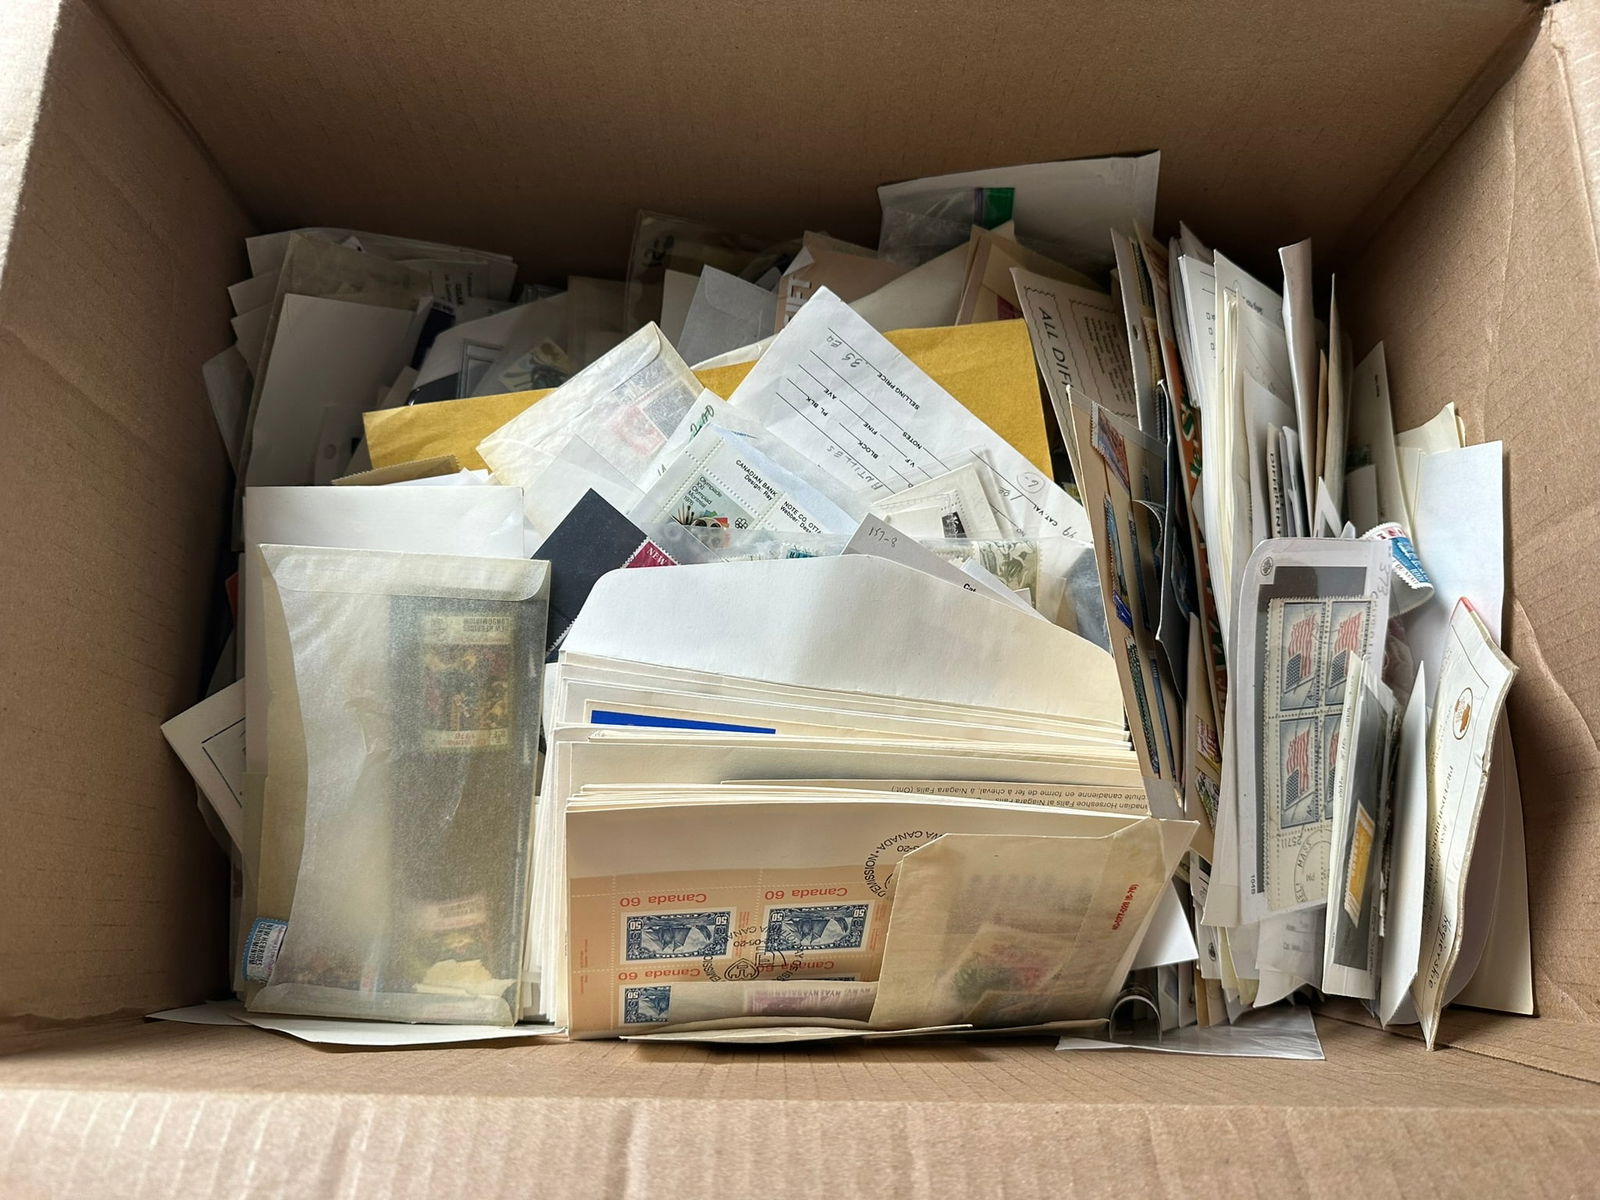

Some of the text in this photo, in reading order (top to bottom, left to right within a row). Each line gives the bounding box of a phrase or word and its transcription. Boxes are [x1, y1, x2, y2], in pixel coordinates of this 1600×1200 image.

[1039, 307, 1058, 339] ALL
[823, 388, 837, 400] AVE
[877, 372, 920, 410] SELLING PRICE
[805, 396, 820, 409] BLK
[862, 422, 878, 436] FINE
[902, 431, 923, 449] NOTES
[857, 440, 879, 460] BLOCK
[699, 476, 723, 498] Olympiade
[735, 459, 762, 485] CANADIAN
[760, 480, 778, 498] BANK
[784, 501, 799, 517] NOTE
[1270, 452, 1281, 535] DIFFERENT
[684, 495, 694, 506] 1976
[691, 485, 712, 505] Olympiad
[744, 474, 763, 492] Design:
[762, 489, 774, 502] Ray
[779, 505, 800, 524] Webber:
[646, 547, 667, 565] NEW
[937, 787, 968, 795] Niagara
[980, 787, 1004, 795] cheval,
[876, 830, 923, 852] CANADA
[1297, 842, 1312, 868] MASS
[619, 893, 707, 907] 60 Canada
[763, 887, 848, 900] 60 Canada
[770, 913, 783, 922] 50
[854, 908, 865, 917] 50
[628, 921, 642, 930] 50
[715, 916, 728, 926] 50
[782, 960, 834, 971] Canada
[617, 968, 701, 981] 60 Canada
[626, 991, 640, 999] 50
